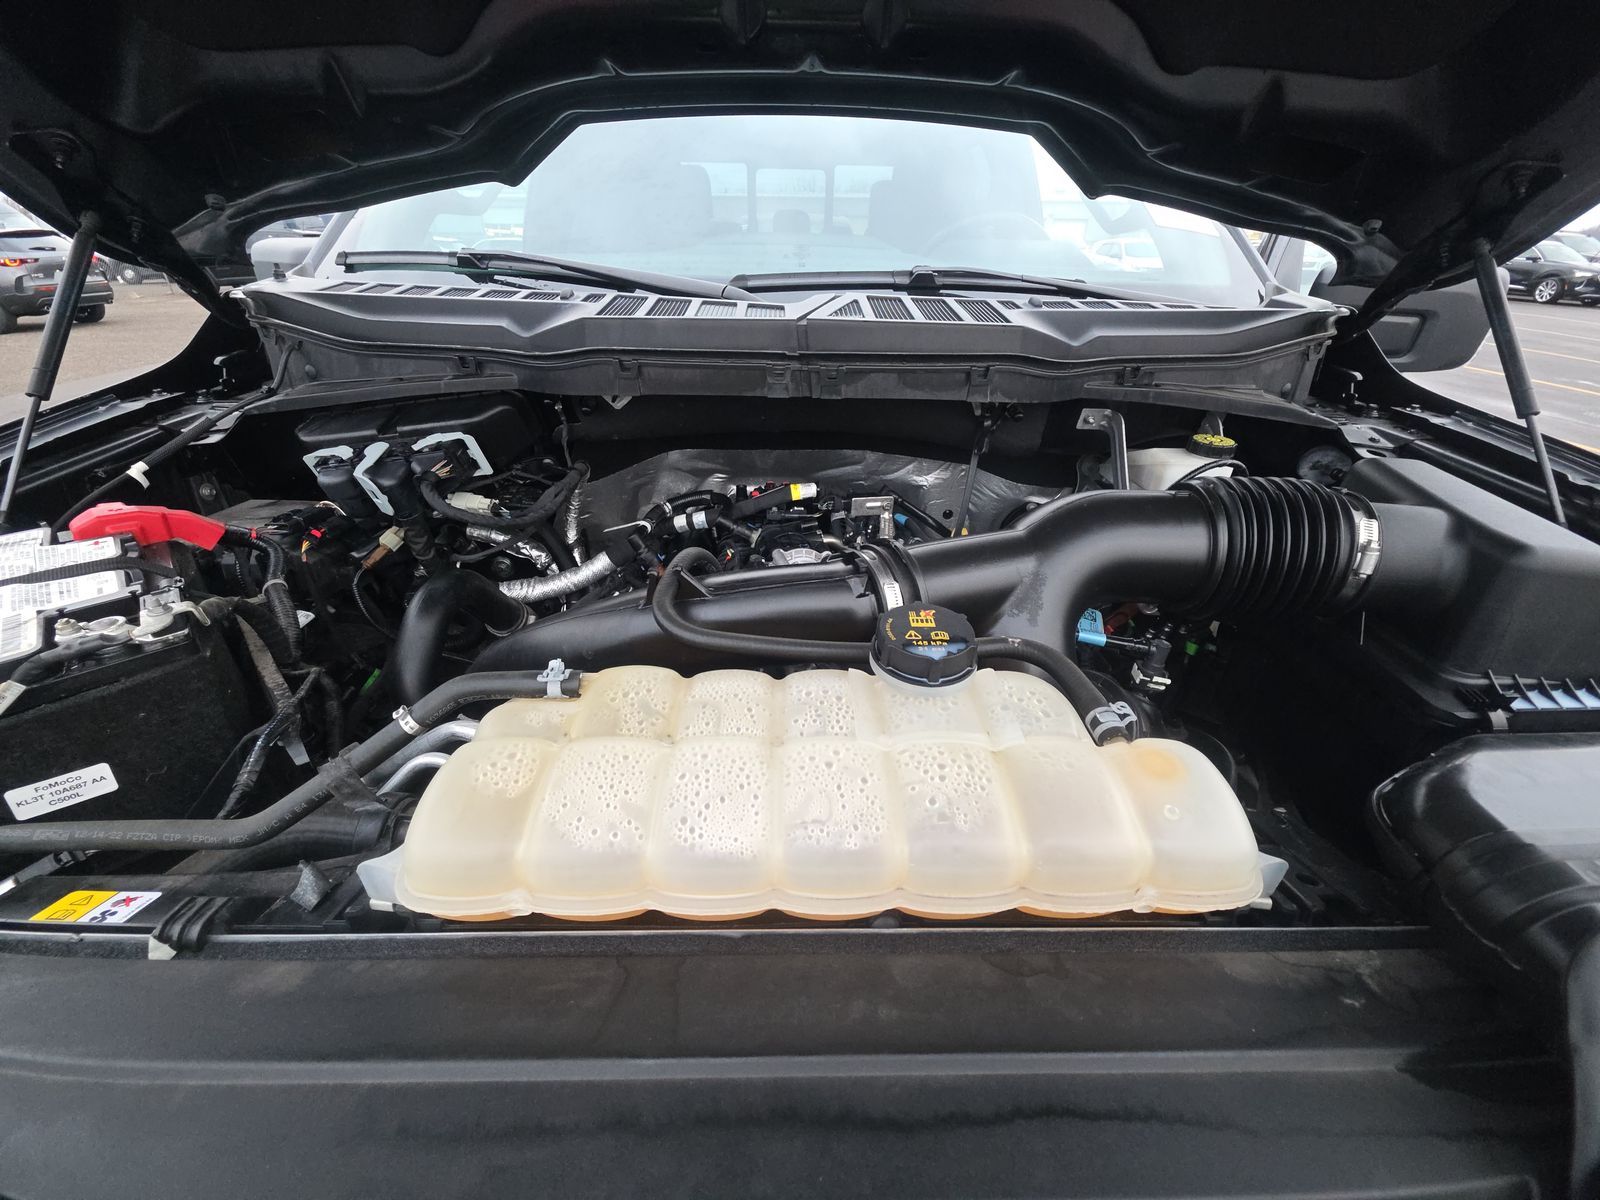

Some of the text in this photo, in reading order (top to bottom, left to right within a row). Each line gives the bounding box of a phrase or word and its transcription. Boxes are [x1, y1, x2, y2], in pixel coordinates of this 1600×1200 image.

[16, 775, 108, 808] KL3T 10A687 AA
[34, 775, 82, 793] FoMoCo
[48, 792, 85, 806] C500L
